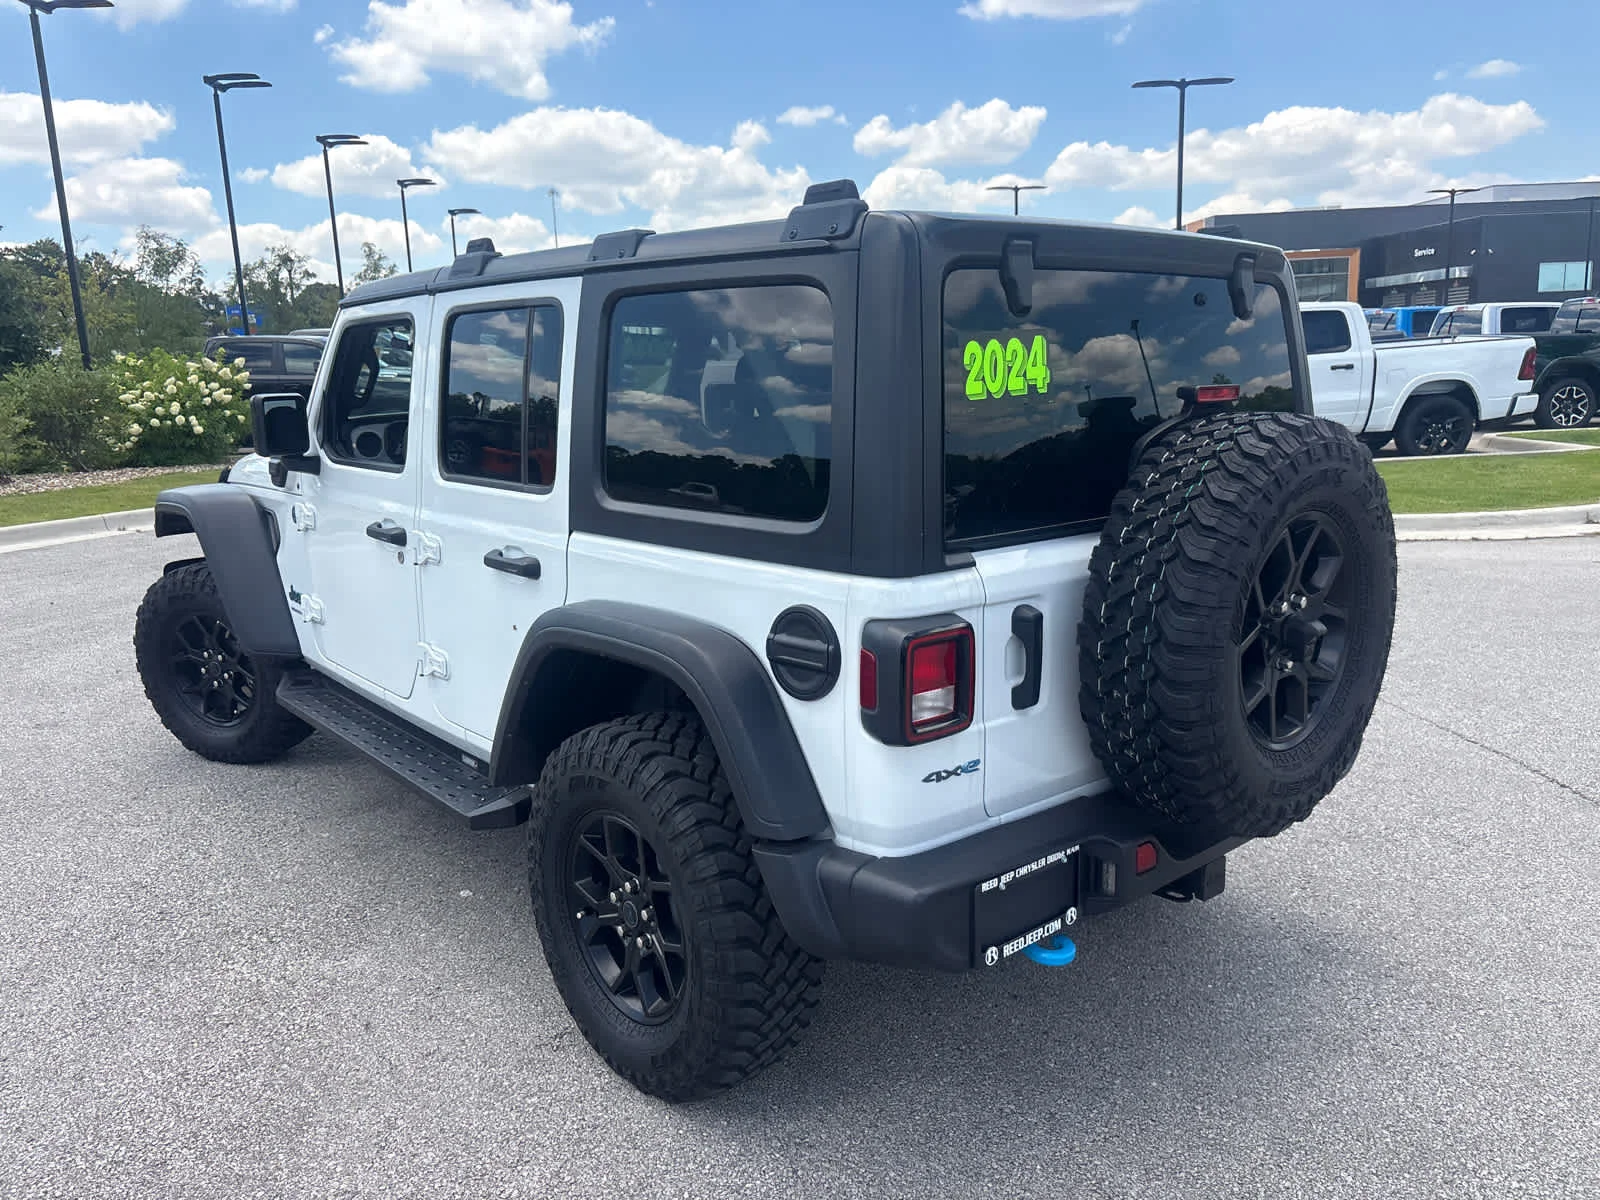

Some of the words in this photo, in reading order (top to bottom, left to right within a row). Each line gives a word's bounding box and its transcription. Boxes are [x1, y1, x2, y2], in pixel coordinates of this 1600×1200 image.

[1414, 248, 1435, 257] Service
[963, 335, 1050, 400] 2024
[981, 877, 998, 893] REED
[1000, 871, 1015, 885] JEEP
[1015, 857, 1046, 878] CHRYSLER
[1003, 918, 1062, 958] REEDJEEP.COM
